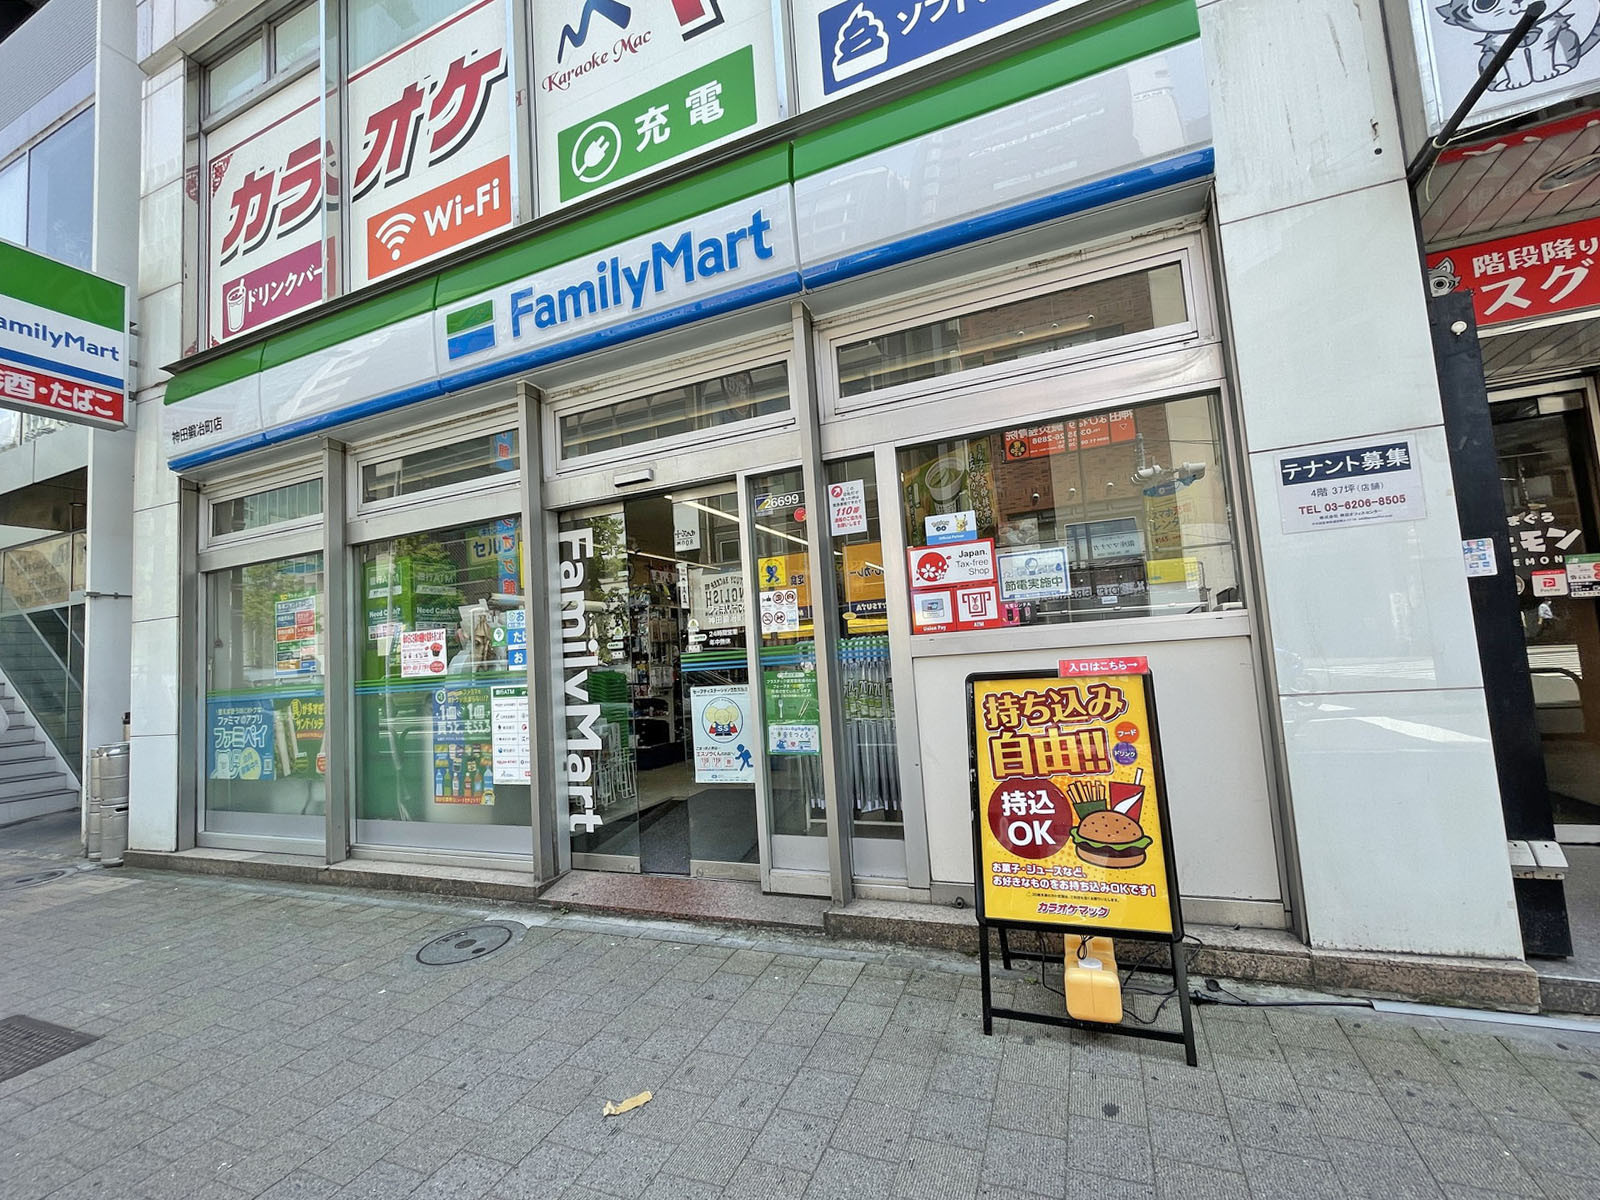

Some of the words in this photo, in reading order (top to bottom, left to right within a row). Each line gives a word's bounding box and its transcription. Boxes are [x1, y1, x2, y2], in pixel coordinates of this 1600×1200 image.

[896, 0, 986, 36] ソフ
[542, 52, 609, 92] Karaoke
[613, 31, 651, 63] Mac
[353, 48, 508, 202] オケ
[636, 80, 723, 152] 充電
[423, 178, 500, 236] Wi-Fi
[1473, 237, 1600, 277] 階段降り
[510, 208, 774, 338] FamilyMart
[248, 263, 322, 313] ドリンクバー
[1480, 256, 1594, 315] スグ
[0, 371, 114, 416] 酒・たばこ
[1282, 448, 1410, 480] テナント募集
[765, 494, 799, 509] 26699
[1311, 487, 1328, 497] 4階
[836, 506, 860, 516] 110番
[1298, 505, 1321, 515] TEL
[1324, 494, 1406, 512] 03-6206-8505
[1506, 511, 1555, 526] まぐろ
[955, 558, 989, 568] Tax-free
[959, 549, 988, 559] Japan.
[968, 567, 990, 576] Shop
[1004, 576, 1063, 592] 節電実施中
[369, 610, 382, 618] Need
[417, 606, 434, 614] Need
[1069, 661, 1127, 673] 入口はこちら
[560, 527, 604, 833] FamilyMart
[985, 685, 1125, 729] 持ち込み
[214, 725, 267, 749] ファミペイ
[1117, 728, 1137, 737] フード
[1114, 749, 1136, 758] ドリンク
[1001, 790, 1056, 817] 持込
[1007, 821, 1056, 847] OK
[992, 863, 1087, 878] お菓子・ジュースなど、
[992, 876, 1157, 896] お好きなものをお持ち込みOKです!
[1037, 902, 1110, 918] カラオケマック
